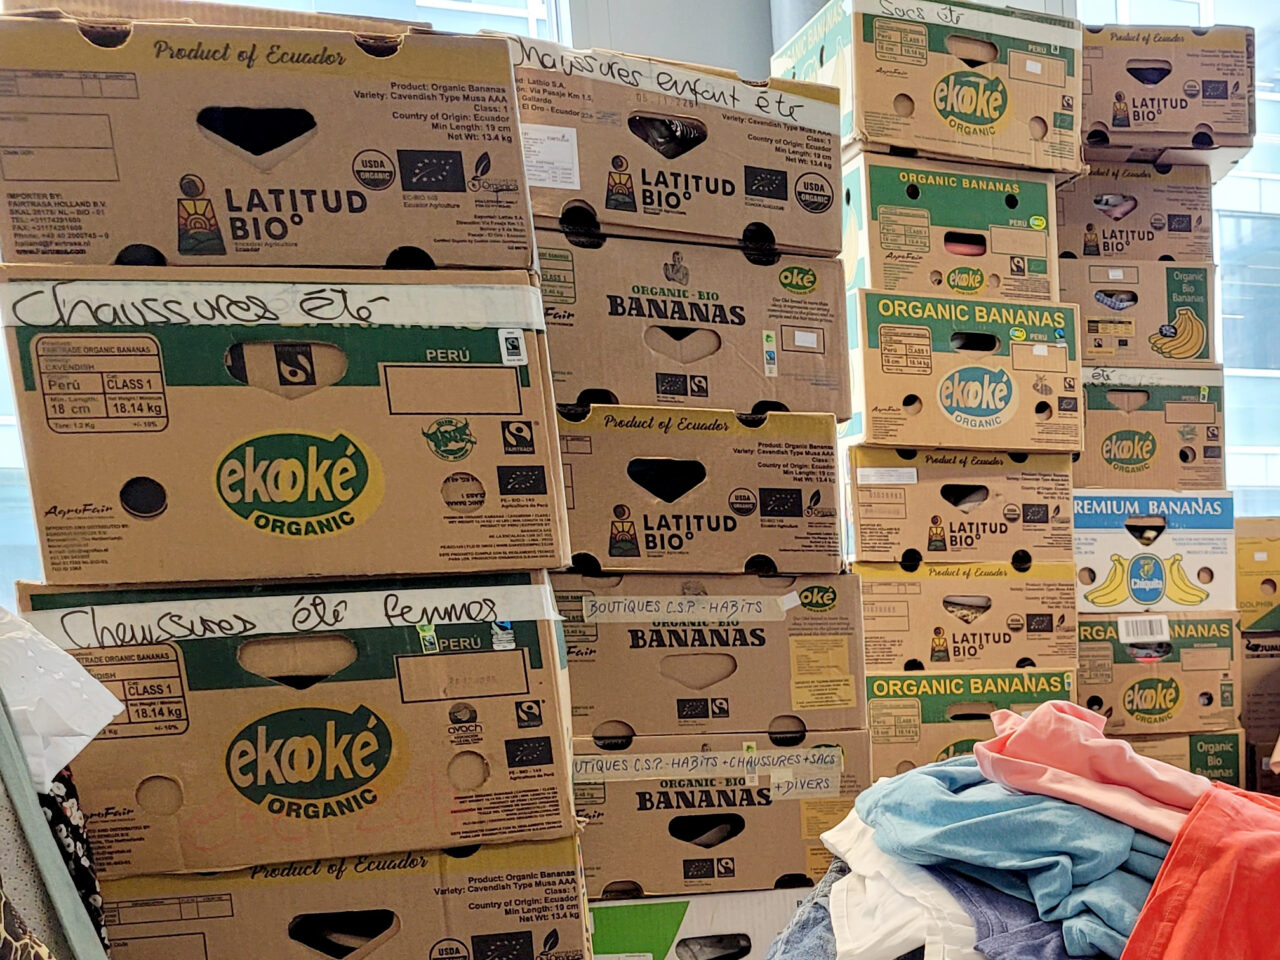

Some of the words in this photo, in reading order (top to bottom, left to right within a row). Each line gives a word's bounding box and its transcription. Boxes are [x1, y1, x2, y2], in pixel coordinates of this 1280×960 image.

[1110, 32, 1140, 42] Product
[1153, 32, 1185, 43] Ecuador
[153, 39, 230, 62] Product
[236, 42, 256, 68] of
[266, 42, 347, 67] Ecuador
[391, 82, 429, 92] Product:
[431, 83, 466, 93] Organic
[468, 84, 506, 94] Bananas
[353, 90, 388, 100] Variety:
[390, 91, 438, 102] Cavendish
[439, 93, 460, 103] Type
[462, 94, 486, 103] Musa
[488, 95, 508, 104] AAA
[657, 70, 741, 108] enfant
[754, 90, 804, 122] été
[936, 73, 1003, 119] ekooké
[474, 104, 501, 113] Class:
[1132, 97, 1188, 110] LATITUD
[392, 111, 428, 122] Country
[441, 113, 472, 123] Origin:
[474, 113, 510, 123] Ecuador
[550, 107, 580, 117] Ecuador
[431, 122, 449, 131] Min
[450, 123, 484, 133] Length:
[948, 118, 996, 136] ORGANIC
[482, 133, 500, 142] 13.4
[805, 142, 832, 152] Ecuador
[361, 159, 386, 169] USDA
[360, 171, 390, 181] ORGANIC
[640, 167, 736, 197] LATITUD
[899, 171, 958, 188] ORGANIC
[962, 179, 1020, 194] BANANAS
[802, 180, 825, 193] USDA
[225, 188, 368, 216] LATITUD
[800, 193, 830, 204] ORGANIC
[1102, 229, 1155, 242] LATITUD
[779, 267, 817, 288] oké
[1173, 271, 1204, 282] Organic
[631, 284, 689, 299] ORGANIC
[697, 289, 720, 301] BIO
[1181, 283, 1194, 293] Bio
[12, 280, 280, 327] Chaussures
[1172, 294, 1204, 303] Bananas
[606, 293, 746, 326] BANANAS
[877, 299, 970, 321] ORGANIC
[974, 305, 1065, 328] BANANAS
[426, 347, 470, 362] PERÚ
[48, 378, 81, 390] Perú
[106, 379, 143, 390] CLASS
[941, 372, 1008, 410] ekooké
[50, 403, 65, 415] 18
[71, 405, 91, 414] cm
[113, 402, 144, 414] 18.14
[147, 402, 162, 416] kg
[603, 414, 655, 431] Product
[657, 416, 672, 434] of
[677, 416, 730, 433] Ecuador
[954, 414, 1002, 429] ORGANIC
[1102, 436, 1153, 461] ekooké
[925, 455, 956, 465] Product
[970, 456, 1004, 466] Ecuador
[218, 445, 359, 504] ekooké
[1112, 462, 1151, 474] ORGANIC
[1073, 500, 1140, 515] REMIUM
[1148, 499, 1222, 515] BANANAS
[253, 510, 357, 538] ORGANIC
[642, 513, 738, 533] LATITUD
[949, 521, 1009, 534] LATITUD
[928, 568, 961, 578] Product
[973, 567, 1008, 578] Ecuador
[800, 586, 836, 606] oké
[439, 634, 482, 650] PERÚ
[627, 627, 766, 650] BANANAS
[951, 632, 1012, 645] LATITUD
[128, 685, 164, 697] CLASS
[873, 679, 964, 696] ORGANIC
[969, 676, 1062, 694] BANANAS
[1124, 677, 1176, 711] ekooké
[134, 708, 166, 719] 18.14
[168, 706, 182, 719] kg
[1134, 713, 1173, 724] ORGANIC
[228, 714, 379, 788] ekooké
[1196, 741, 1234, 755] Organic
[1207, 755, 1223, 767] Bio
[660, 778, 717, 788] ORGANIC
[725, 777, 746, 787] BIO
[267, 788, 378, 820] ORGANIC
[635, 787, 773, 811] BANANAS
[249, 860, 321, 880] Product
[326, 857, 348, 880] of
[353, 851, 429, 873] Ecuador
[468, 874, 504, 884] Product:
[505, 872, 538, 882] Organic
[540, 869, 576, 879] Bananas
[433, 886, 465, 896] Variety:
[467, 883, 512, 894] Cavendish
[513, 881, 534, 891] Type
[534, 878, 556, 887] Musa
[557, 877, 577, 886] AAA
[544, 886, 571, 895] Class:
[468, 901, 502, 912] Country
[514, 897, 542, 908] Origin:
[544, 894, 578, 904] Ecuador
[504, 907, 521, 916] Min
[522, 904, 553, 916] Length:
[550, 912, 569, 921] 13.4
[437, 946, 461, 956] USDA
